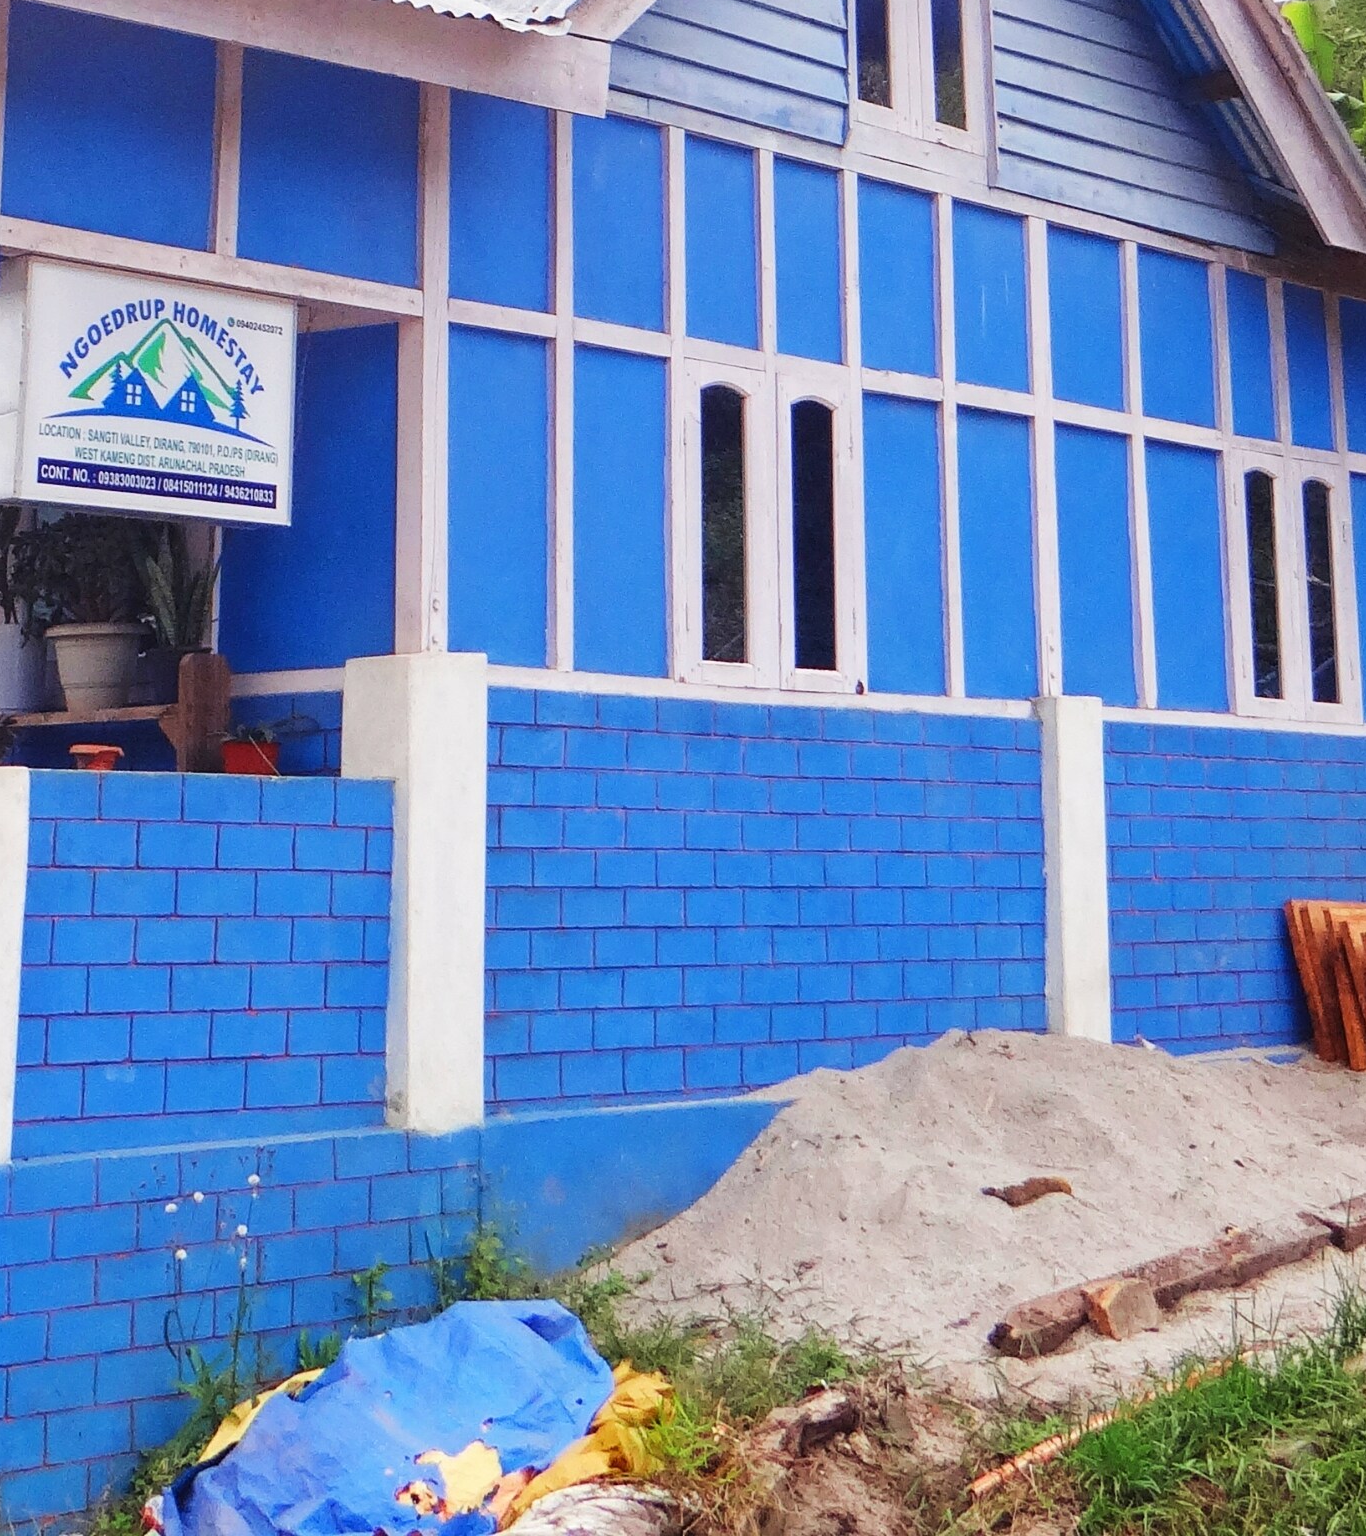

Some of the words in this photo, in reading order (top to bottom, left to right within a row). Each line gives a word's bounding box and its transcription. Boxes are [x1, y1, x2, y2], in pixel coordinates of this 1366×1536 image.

[59, 298, 165, 379] NGOEDRUP
[173, 301, 264, 395] HOMESTAY
[39, 423, 82, 440] LOCATION
[88, 429, 119, 444] SANGTI
[120, 433, 152, 450] VALLEY,
[154, 437, 185, 453] DIRANG,
[244, 448, 278, 467] (DIRANG)
[75, 447, 98, 460] WEST
[100, 449, 135, 465] KAMENG
[137, 454, 156, 468] DIST.
[158, 456, 207, 474] ARUNACHAL
[208, 462, 245, 478] PRADESH
[41, 464, 71, 481] CONT.
[73, 468, 91, 483] NO.
[98, 471, 156, 491] 09383003023
[163, 478, 218, 496] 08415011124
[224, 486, 274, 504] 9436210833
